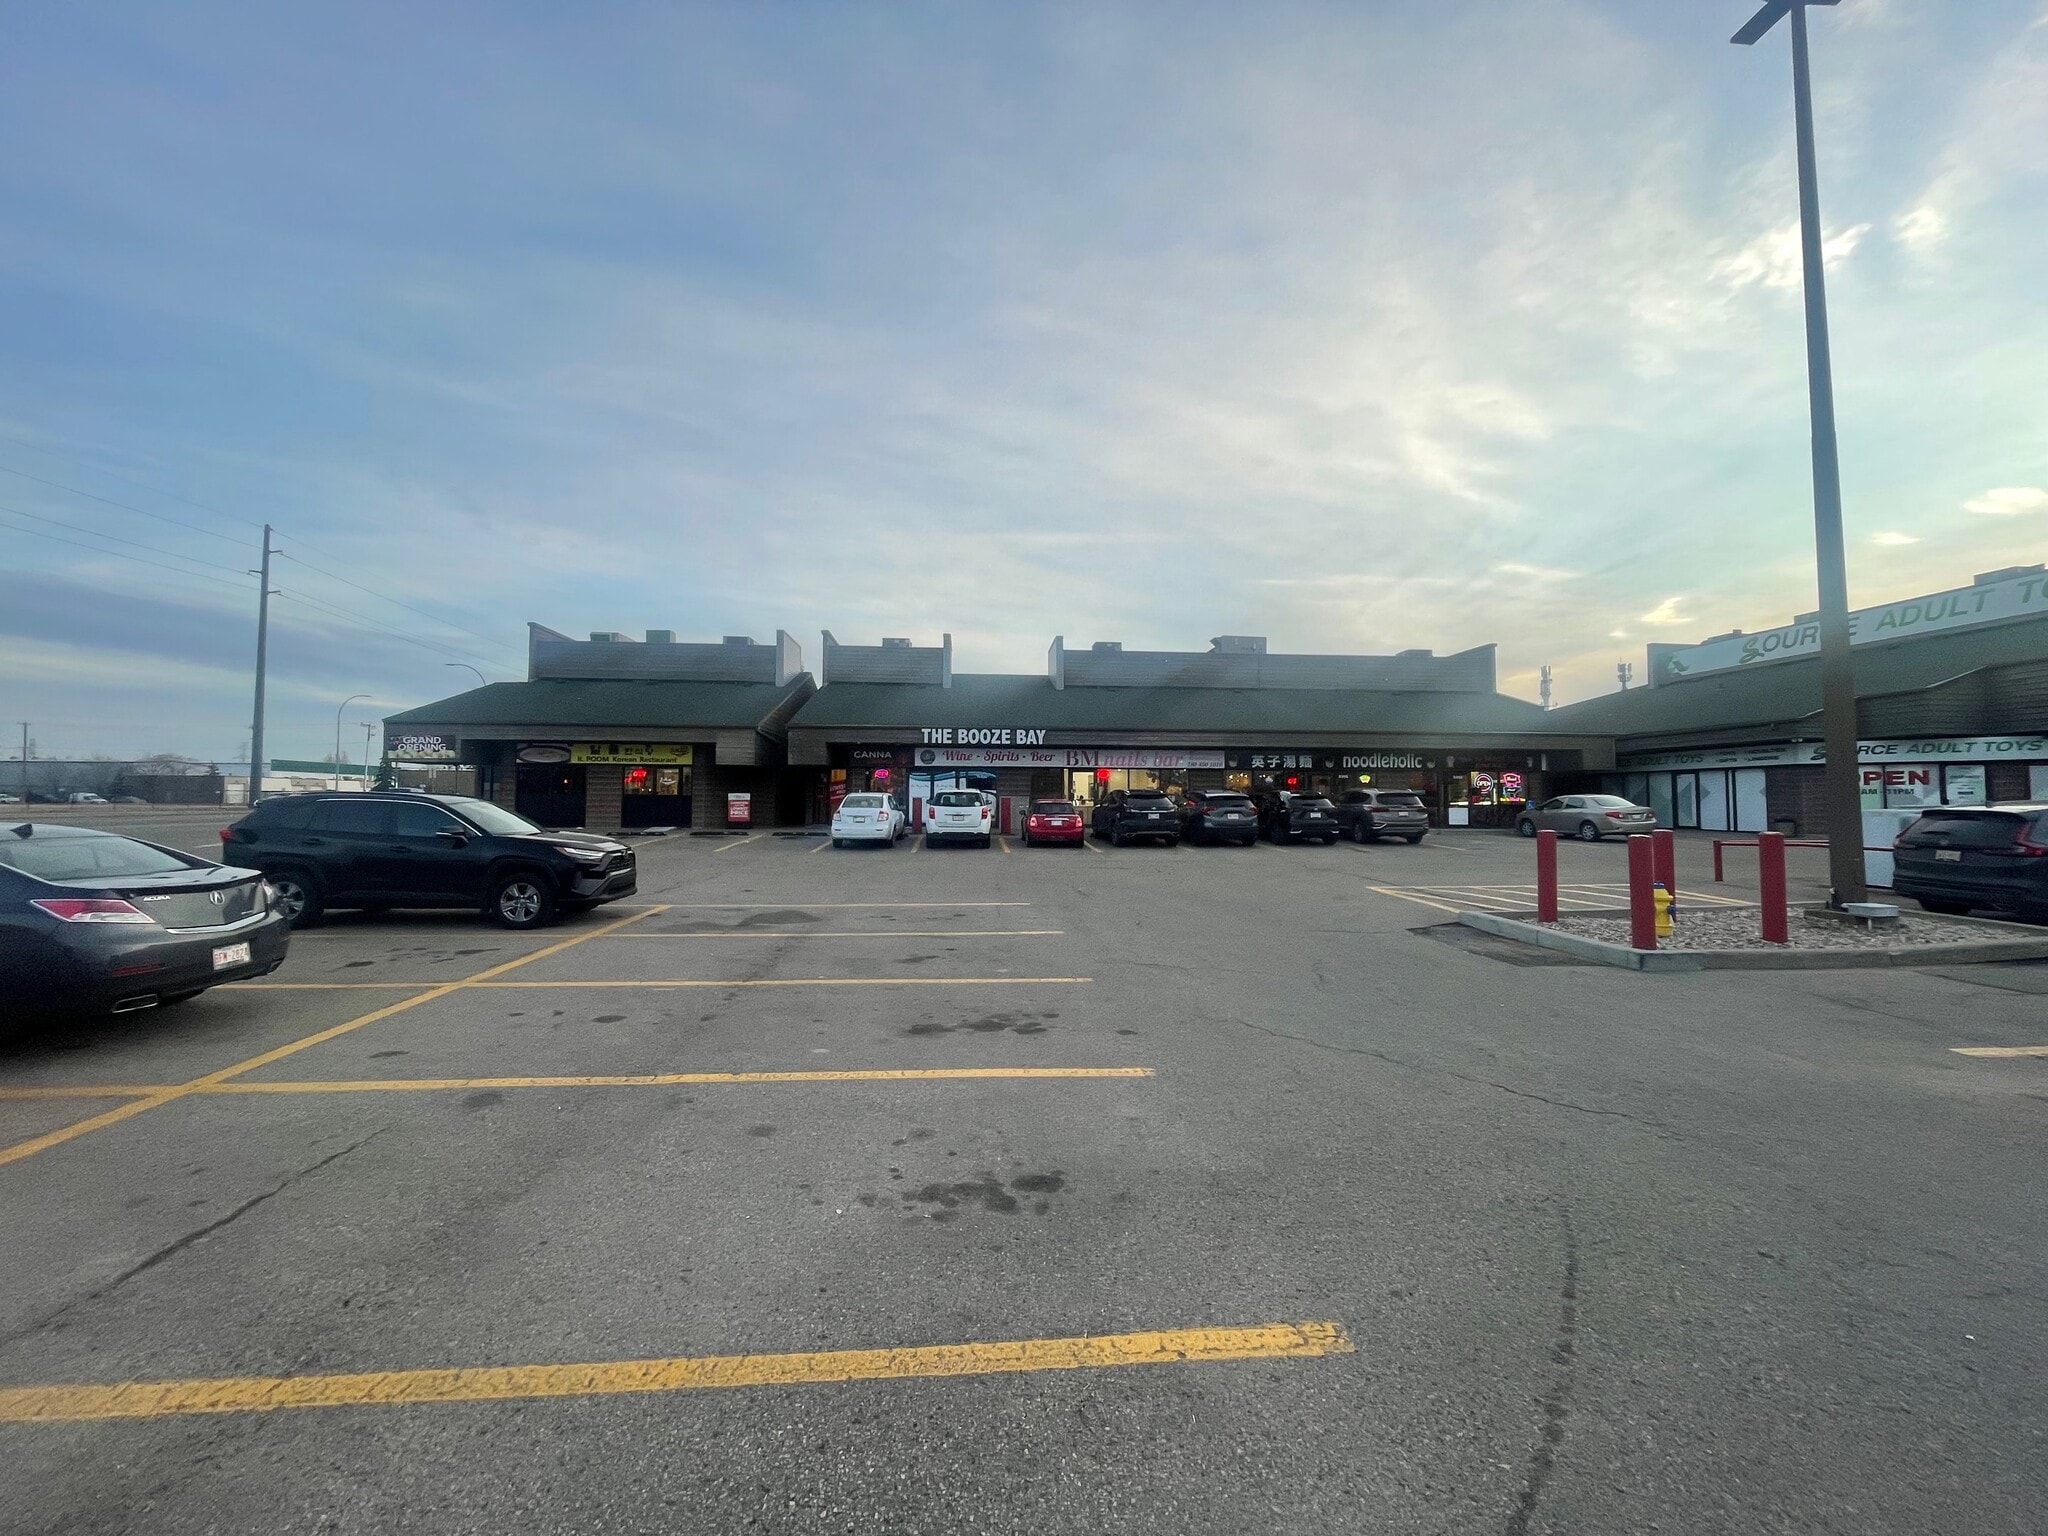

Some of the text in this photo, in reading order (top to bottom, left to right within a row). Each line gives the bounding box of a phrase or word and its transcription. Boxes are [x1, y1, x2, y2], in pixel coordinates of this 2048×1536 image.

[1739, 616, 1860, 664] SOURE
[1875, 588, 1995, 631] ADULT
[402, 736, 442, 744] GRAND
[921, 728, 1046, 744] THE BOOZE BAY
[397, 743, 447, 751] OPENING
[1905, 741, 1976, 754] ADULT
[1983, 740, 2043, 752] TOYS
[853, 751, 892, 759] CANNA
[942, 750, 1055, 763] Wine Spirits Beer
[1065, 750, 1099, 766] BM
[1103, 751, 1148, 767] nails
[1343, 753, 1423, 769] noodleholic
[1859, 770, 1930, 786] PEN
